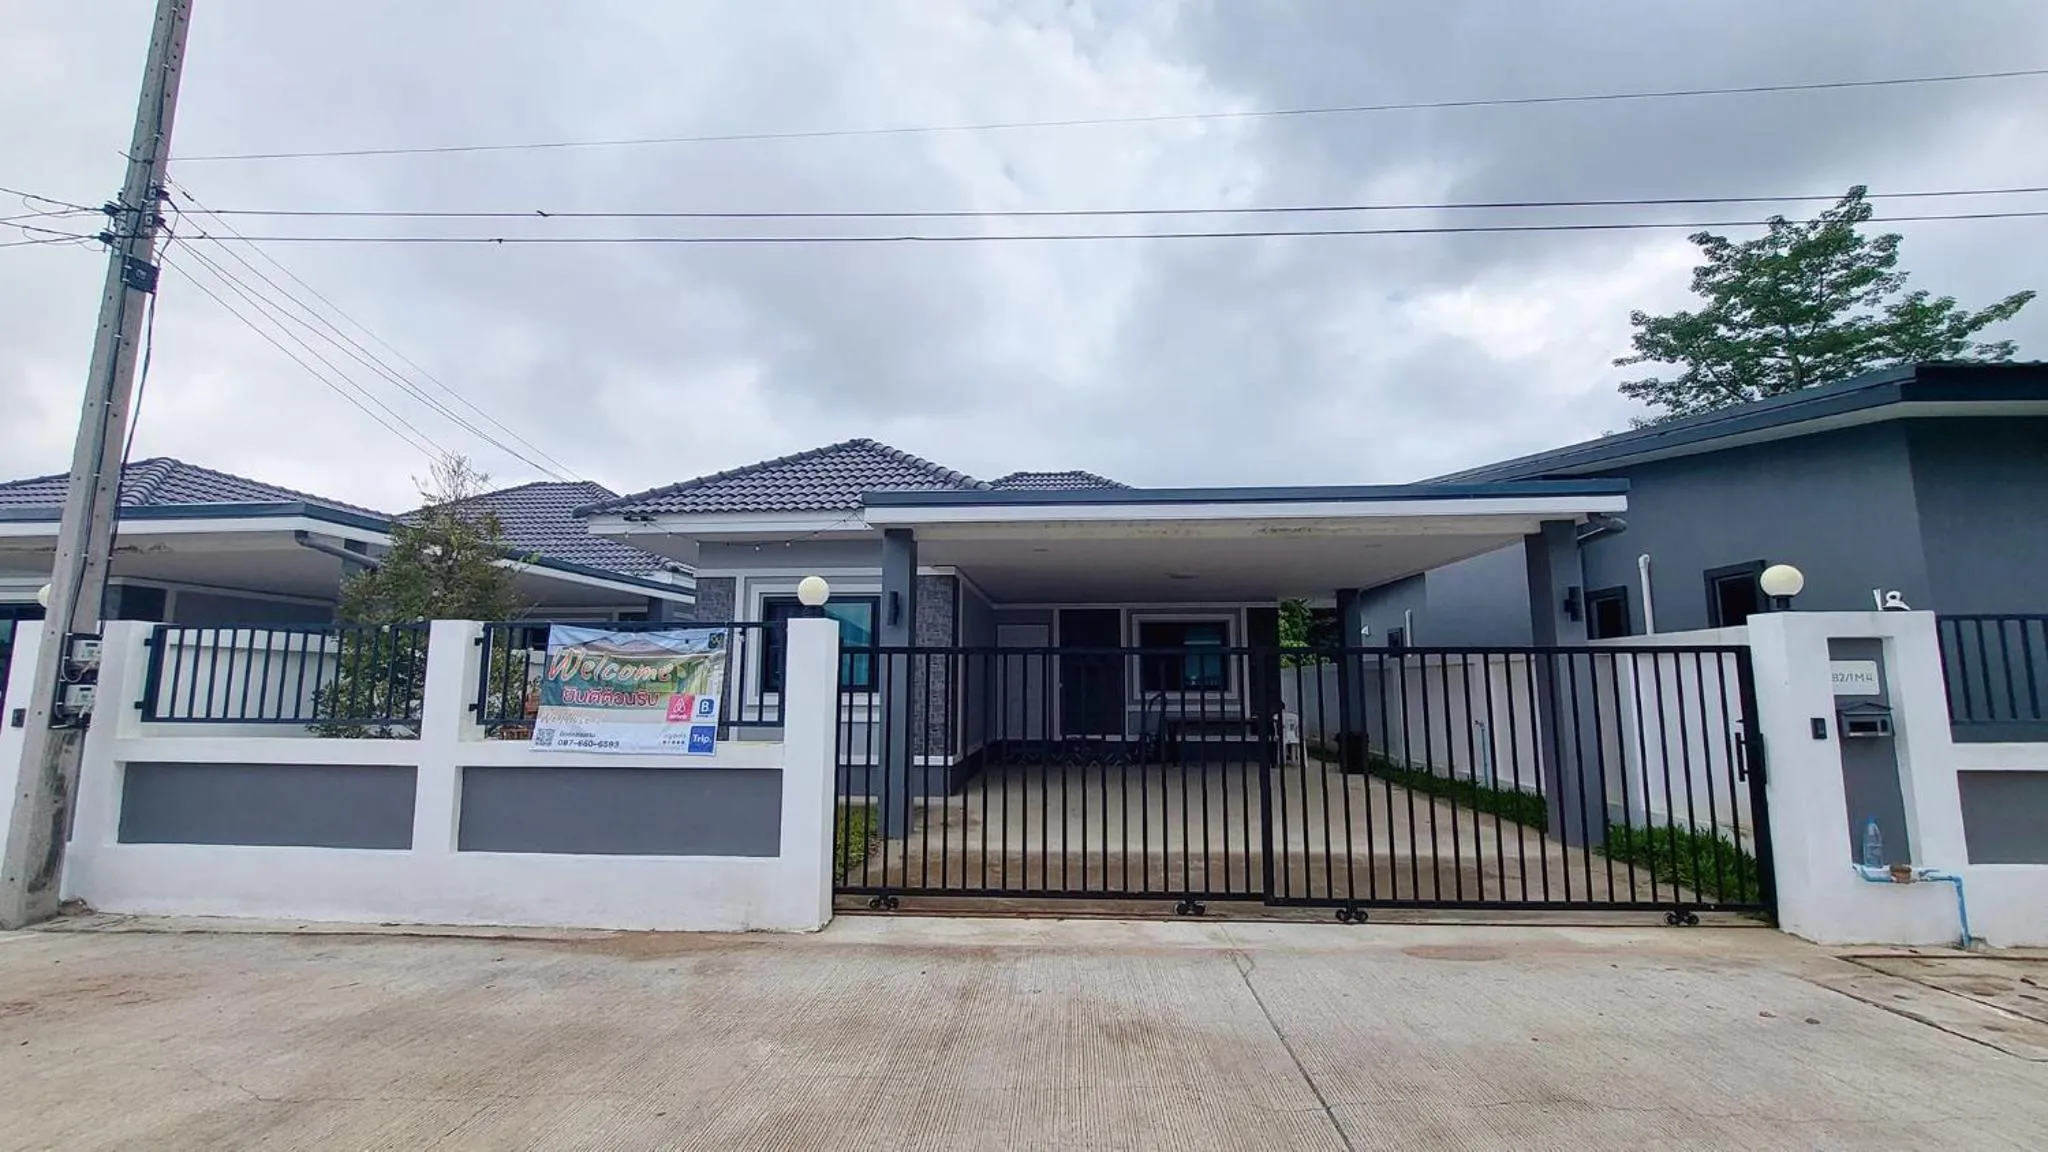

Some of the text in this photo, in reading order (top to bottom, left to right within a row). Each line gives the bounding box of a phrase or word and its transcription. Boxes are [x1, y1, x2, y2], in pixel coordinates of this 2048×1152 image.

[547, 645, 674, 683] Welcome
[562, 685, 661, 707] ยินดีต้อนรับ
